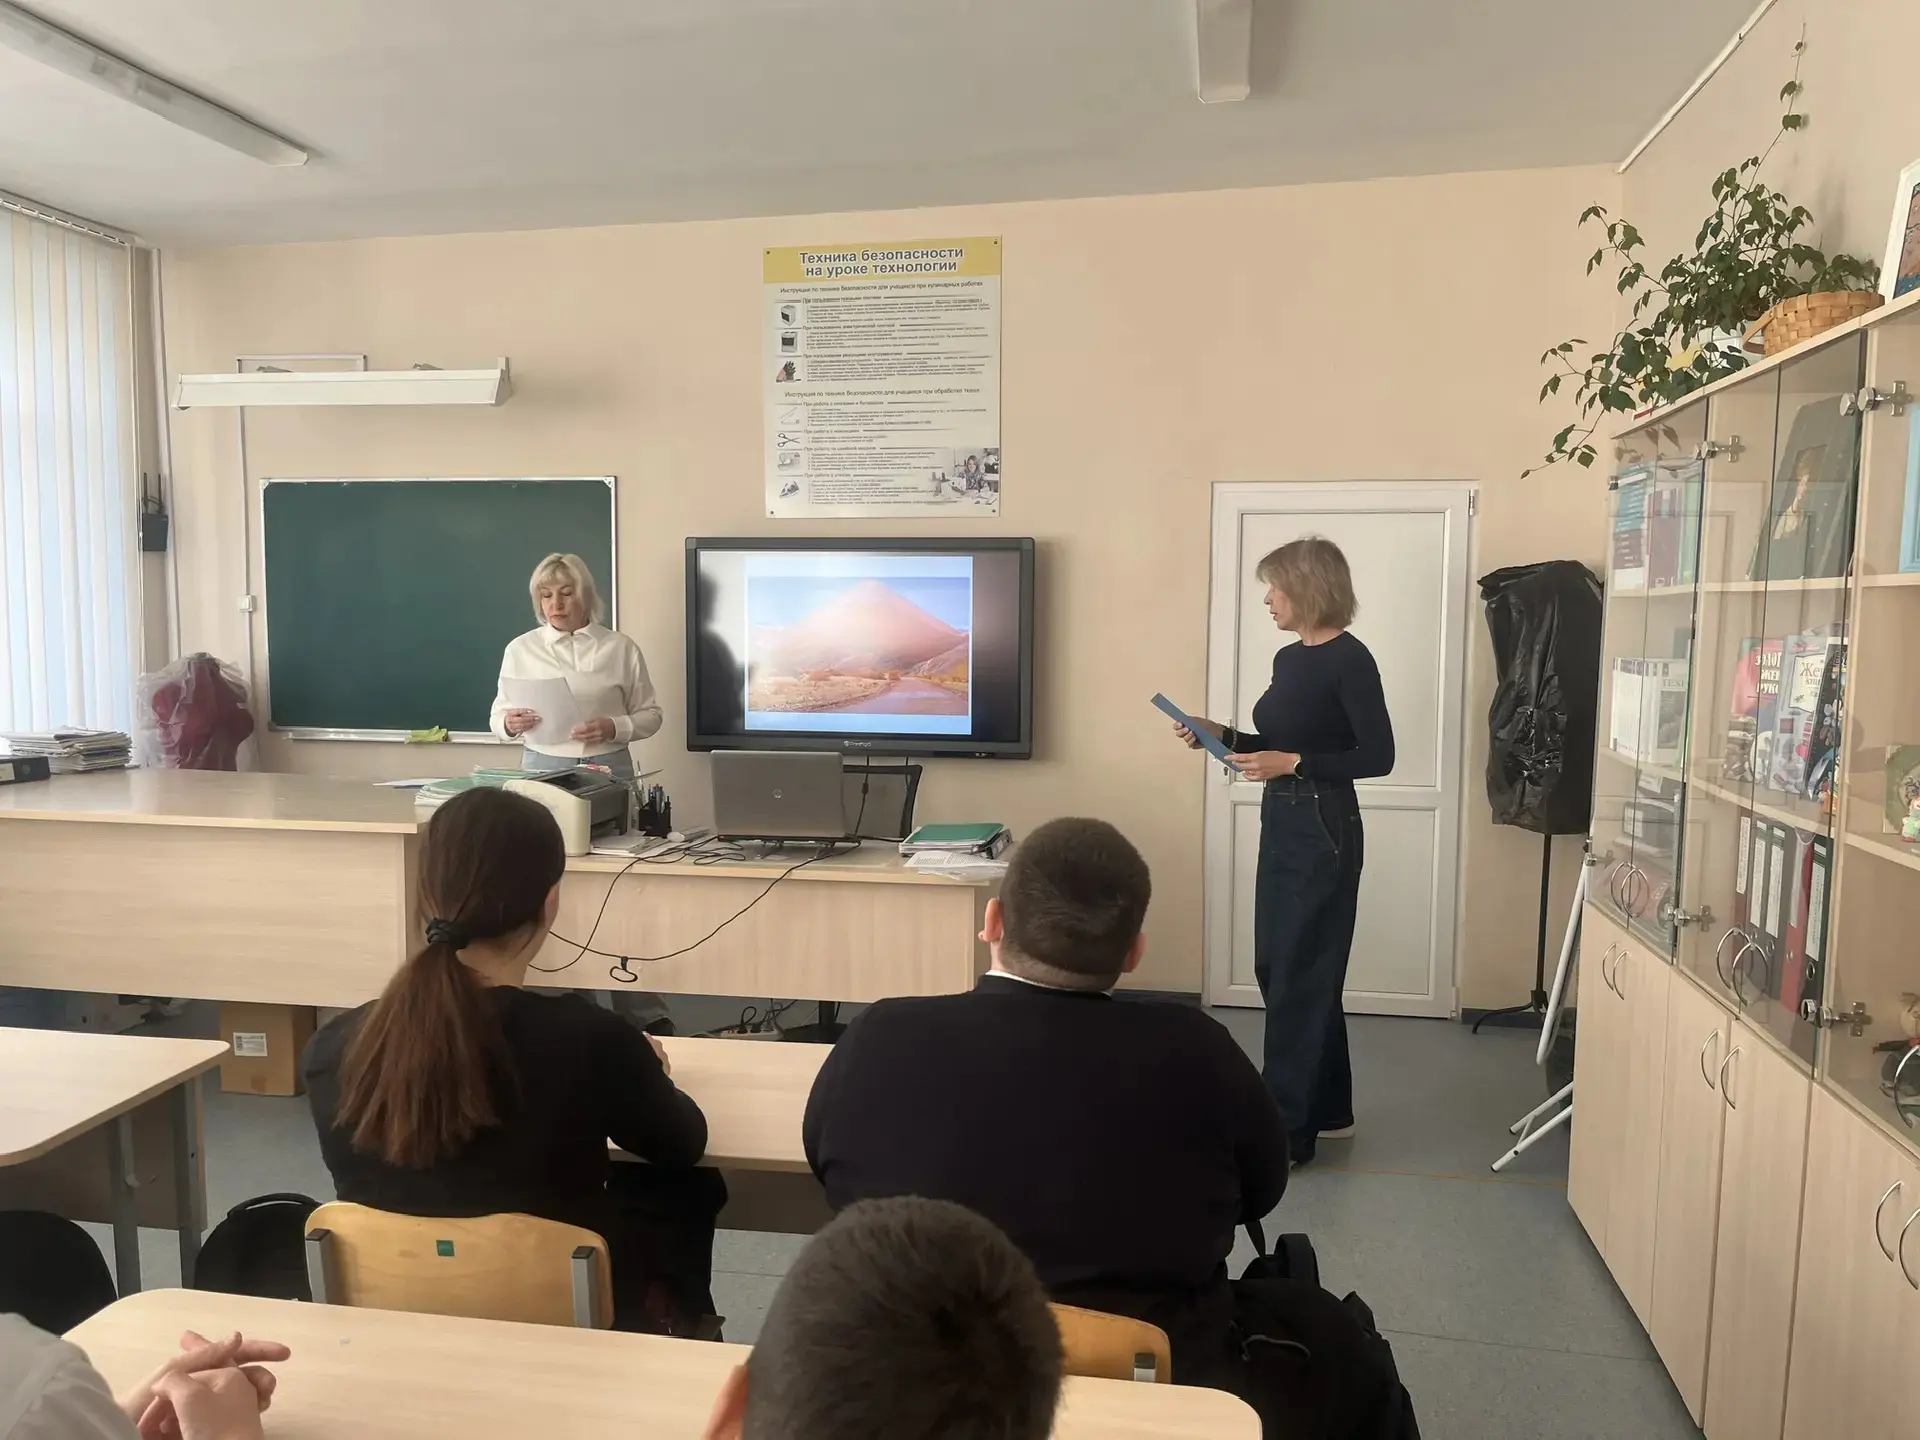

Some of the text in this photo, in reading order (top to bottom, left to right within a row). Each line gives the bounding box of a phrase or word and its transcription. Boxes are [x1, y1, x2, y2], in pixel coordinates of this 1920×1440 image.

[800, 247, 964, 264] Техника безопасности
[806, 261, 958, 278] на уроке технологии
